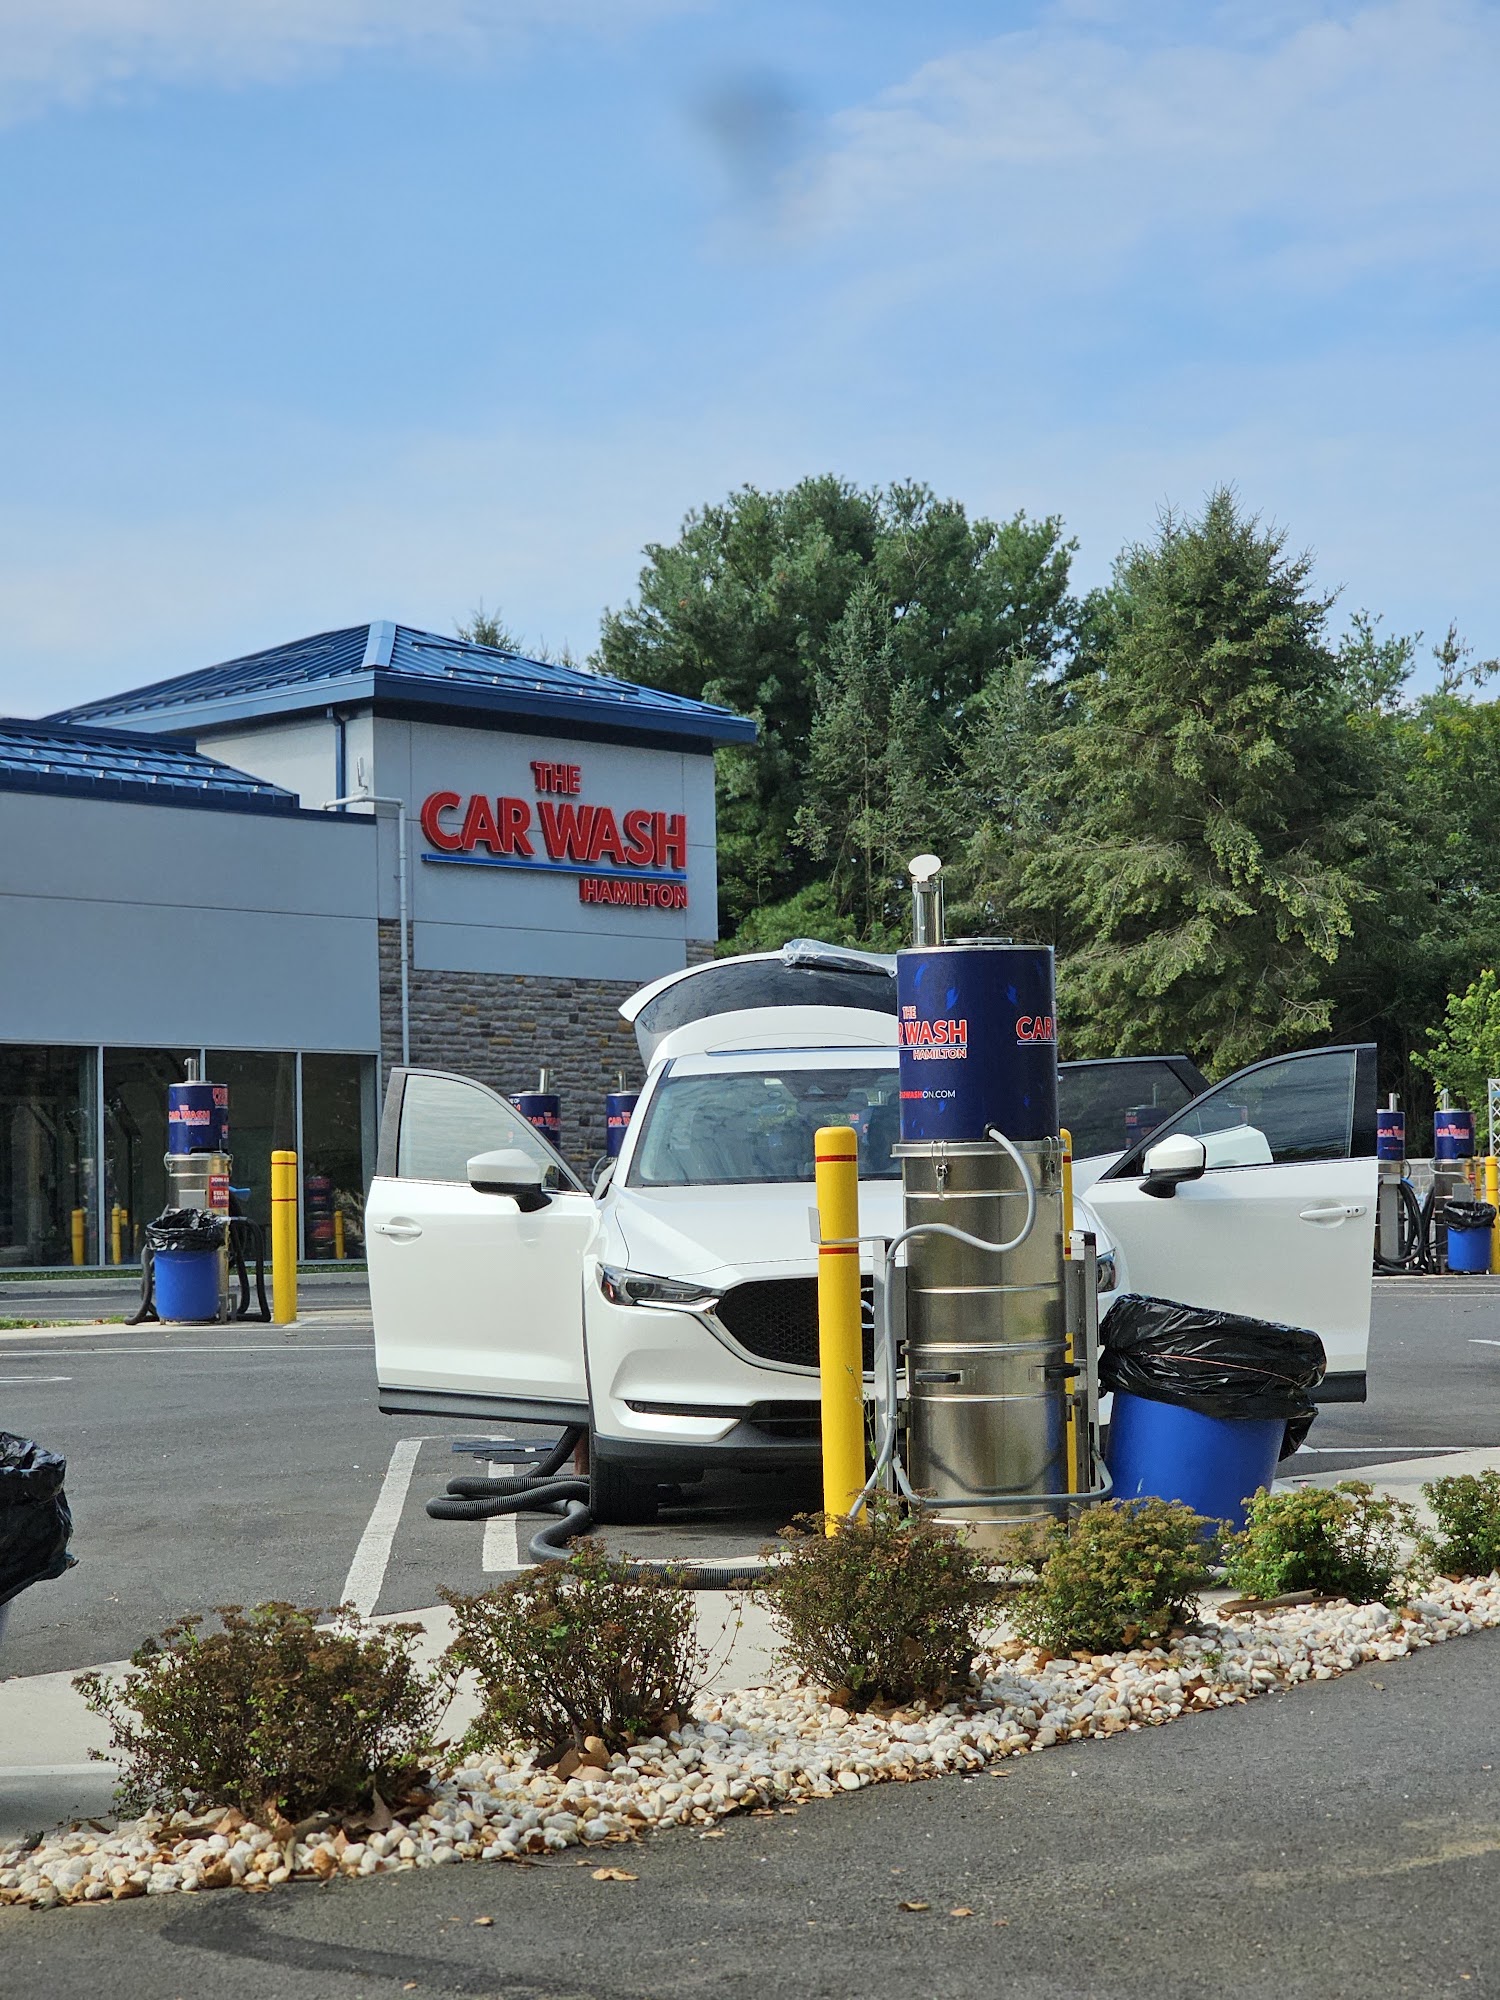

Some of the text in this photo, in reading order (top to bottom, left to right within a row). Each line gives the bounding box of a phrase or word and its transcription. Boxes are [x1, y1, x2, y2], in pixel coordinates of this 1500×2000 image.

[531, 761, 581, 794] THE
[421, 791, 686, 869] CAR WASH
[579, 879, 687, 908] HAMILTON
[902, 1005, 917, 1020] THE
[905, 1020, 967, 1045] WASH
[1016, 1016, 1053, 1040] CAR
[913, 1048, 967, 1060] HAMILTON
